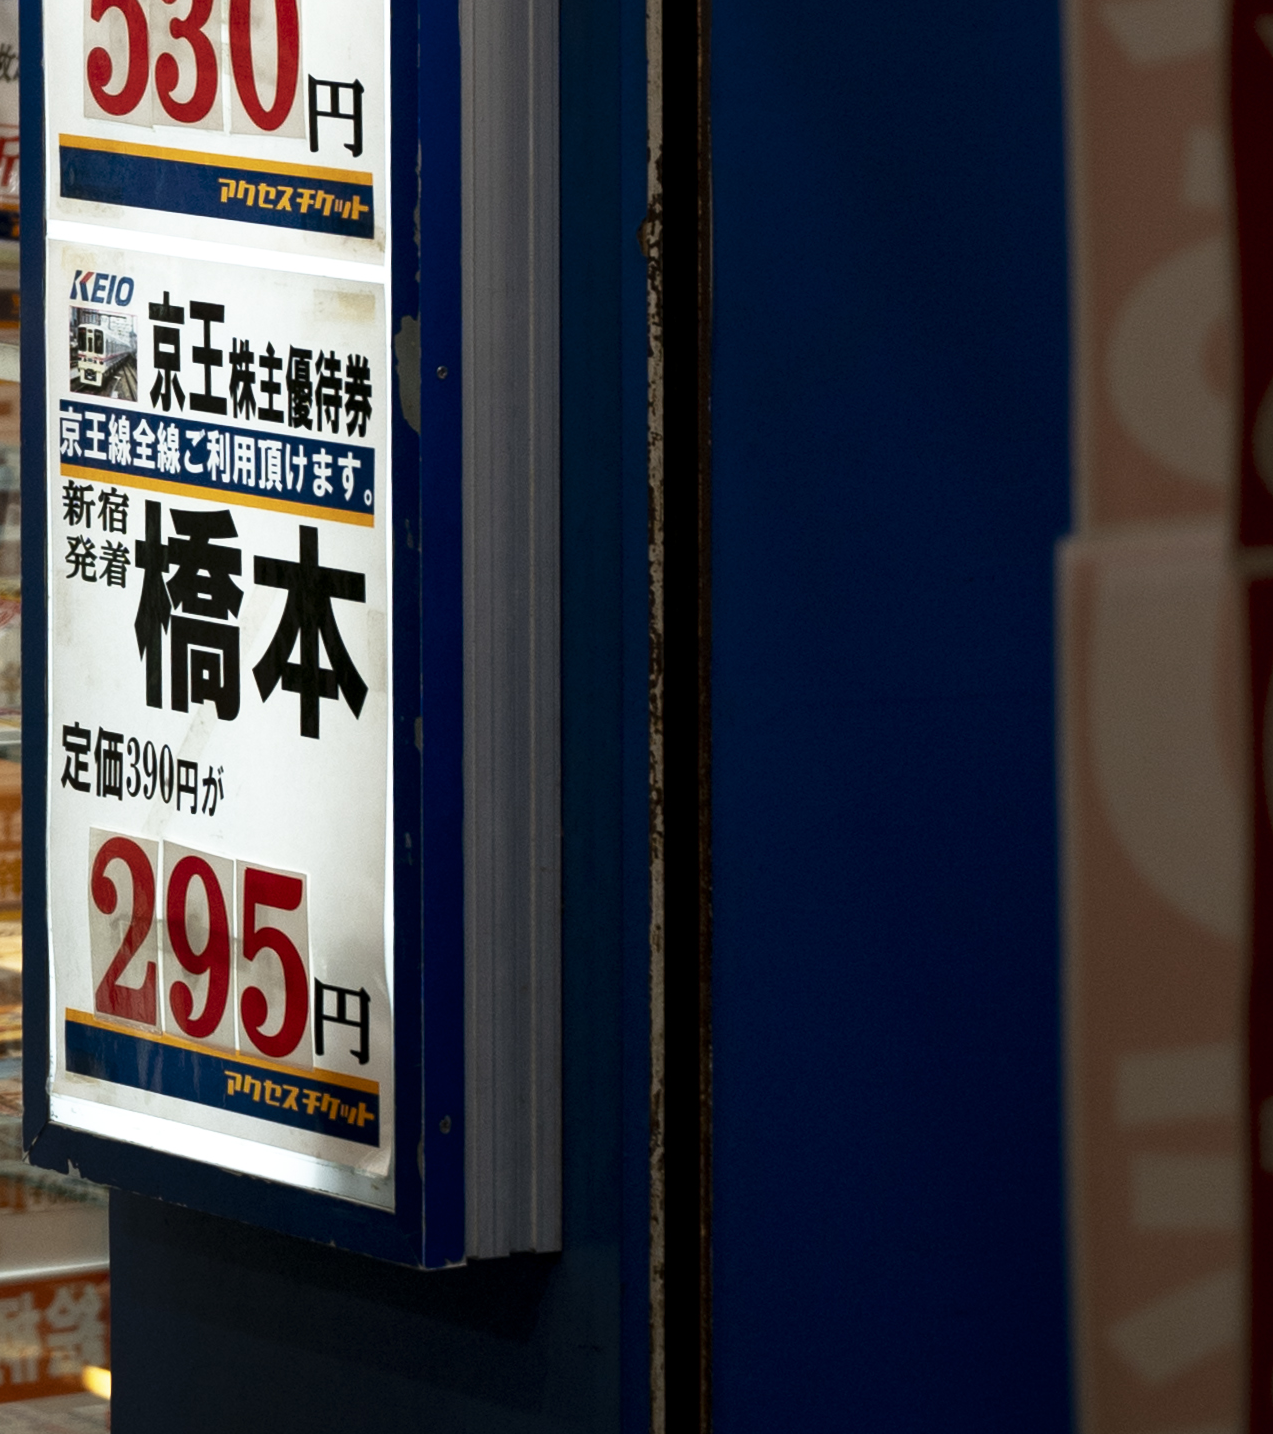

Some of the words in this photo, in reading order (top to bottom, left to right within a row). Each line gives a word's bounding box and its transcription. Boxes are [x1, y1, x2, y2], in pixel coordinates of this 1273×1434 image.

[218, 177, 370, 221] アクセスチケット
[69, 268, 135, 308] KEIO
[148, 291, 373, 440] 京王株主優待券
[59, 407, 375, 506] 京王線全線ご利用頂けます。
[61, 479, 131, 535] 新宿
[64, 535, 132, 590] 発着
[133, 498, 369, 741] 橋本
[60, 722, 225, 820] 定価390円が
[225, 1067, 375, 1127] アクセスチケット
